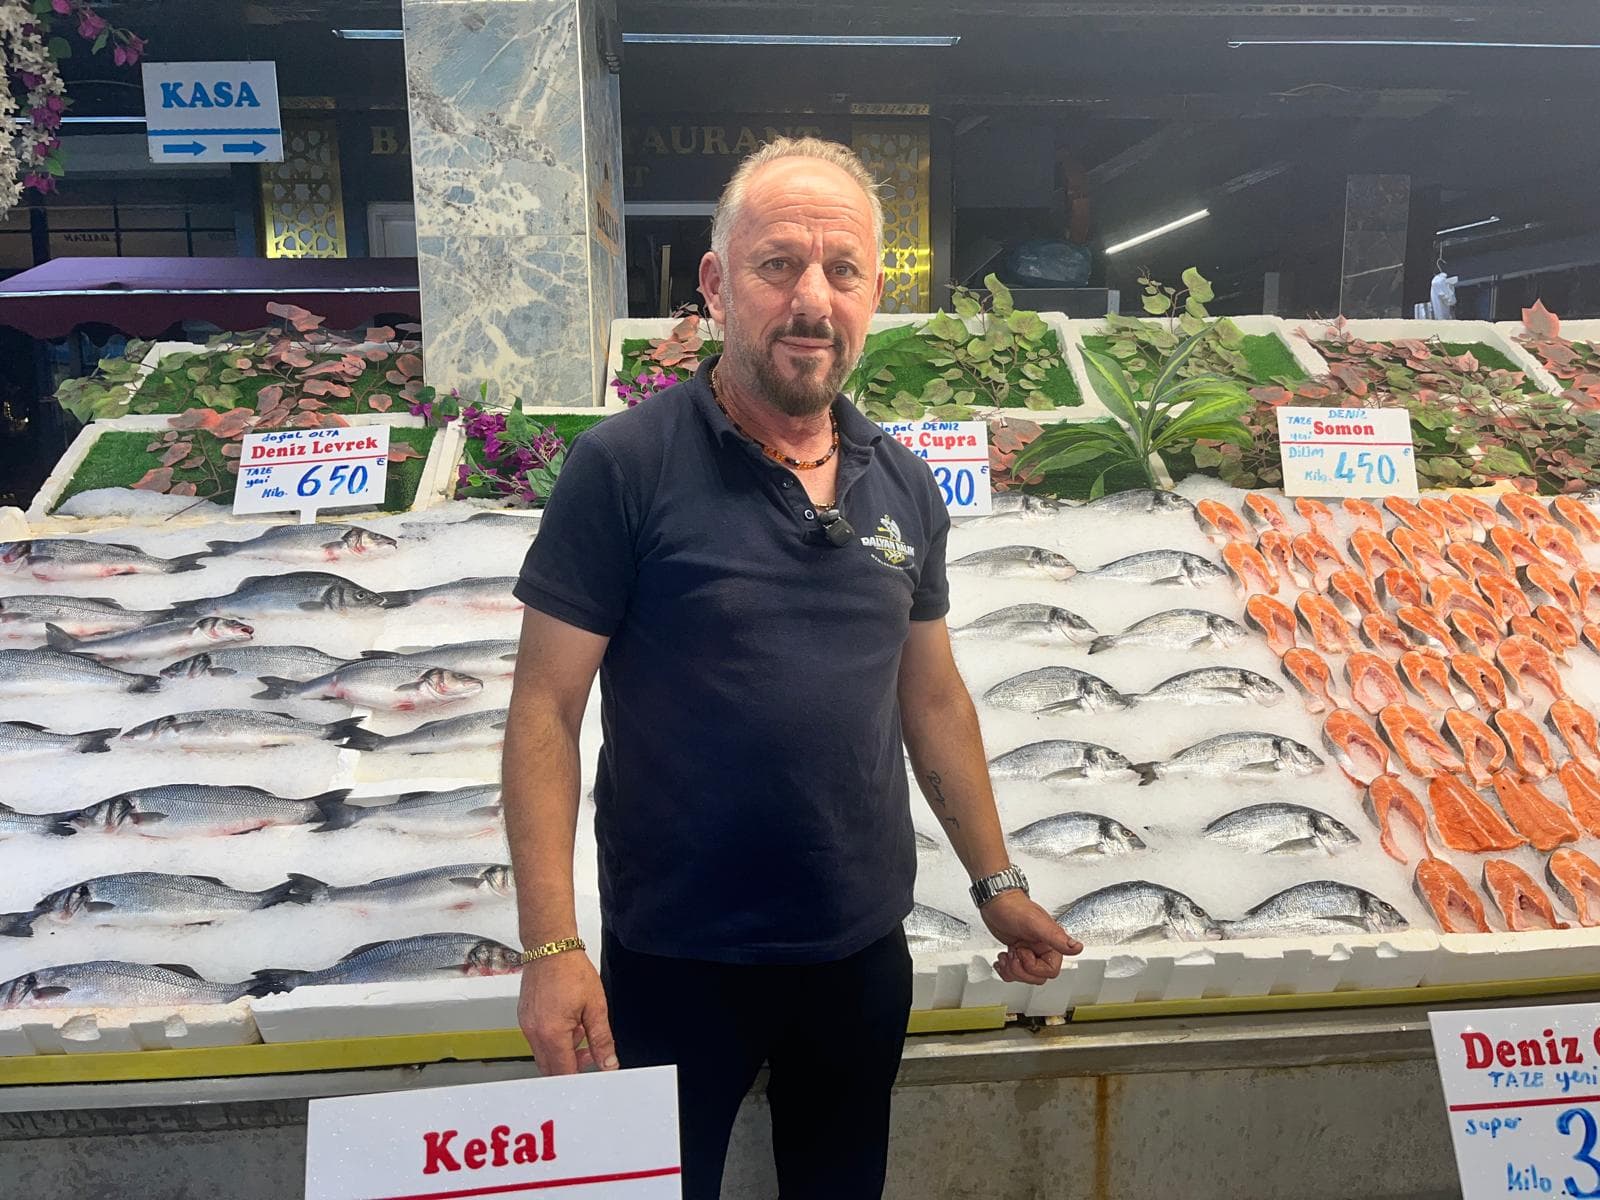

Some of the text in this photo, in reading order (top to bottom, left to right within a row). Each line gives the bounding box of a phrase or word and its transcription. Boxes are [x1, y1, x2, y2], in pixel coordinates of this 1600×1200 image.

[160, 81, 261, 108] KASA
[918, 431, 977, 450] Cupra
[1313, 420, 1375, 436] Somon
[250, 436, 378, 459] Deniz Levrek
[1460, 1028, 1584, 1069] Deniz
[422, 1119, 557, 1175] Kefal
